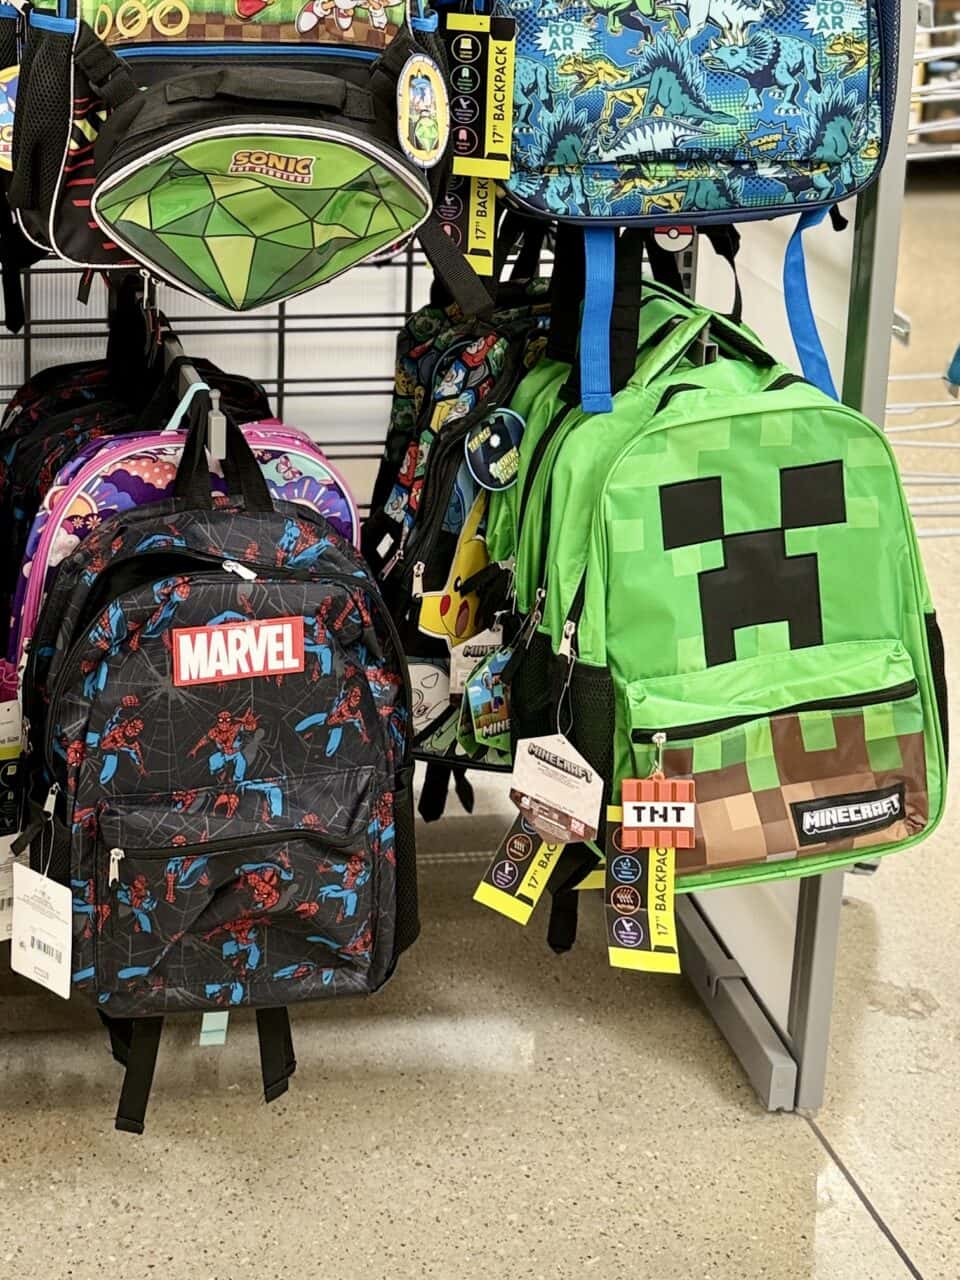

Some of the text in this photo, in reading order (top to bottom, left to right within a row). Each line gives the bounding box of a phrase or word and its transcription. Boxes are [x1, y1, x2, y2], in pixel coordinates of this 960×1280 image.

[816, 2, 845, 16] RO
[548, 22, 575, 37] RO
[817, 16, 844, 30] AR
[548, 37, 574, 51] AR
[491, 45, 508, 145] 17" BACKPACK
[234, 151, 313, 175] SONIC
[475, 177, 489, 240] 17" BACK
[178, 623, 300, 681] MARVEL
[6, 734, 20, 745] Size
[527, 742, 593, 784] MINECRAFT
[632, 805, 686, 823] TNT
[803, 794, 901, 835] MINECRAFT
[526, 870, 539, 889] 17"
[654, 847, 669, 937] 17" BACKPAC
